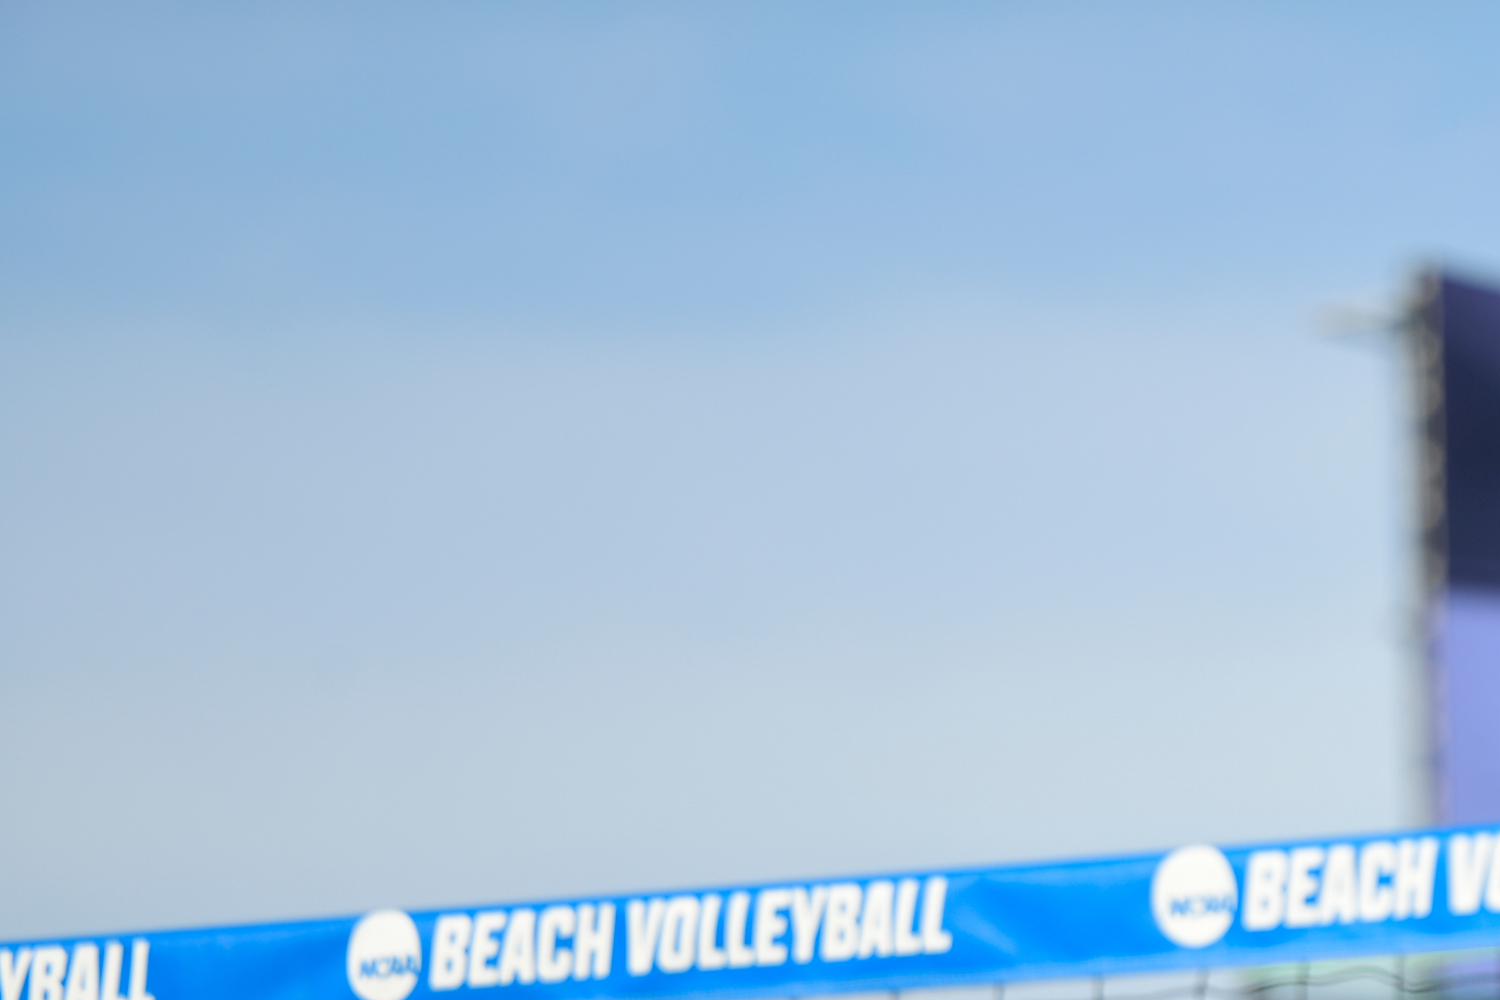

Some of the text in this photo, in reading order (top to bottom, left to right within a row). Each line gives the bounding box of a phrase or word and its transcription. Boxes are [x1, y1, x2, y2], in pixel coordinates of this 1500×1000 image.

[428, 901, 617, 992] BEACH
[625, 875, 953, 977] VOLLEYBALL
[1241, 836, 1440, 932] BEACH
